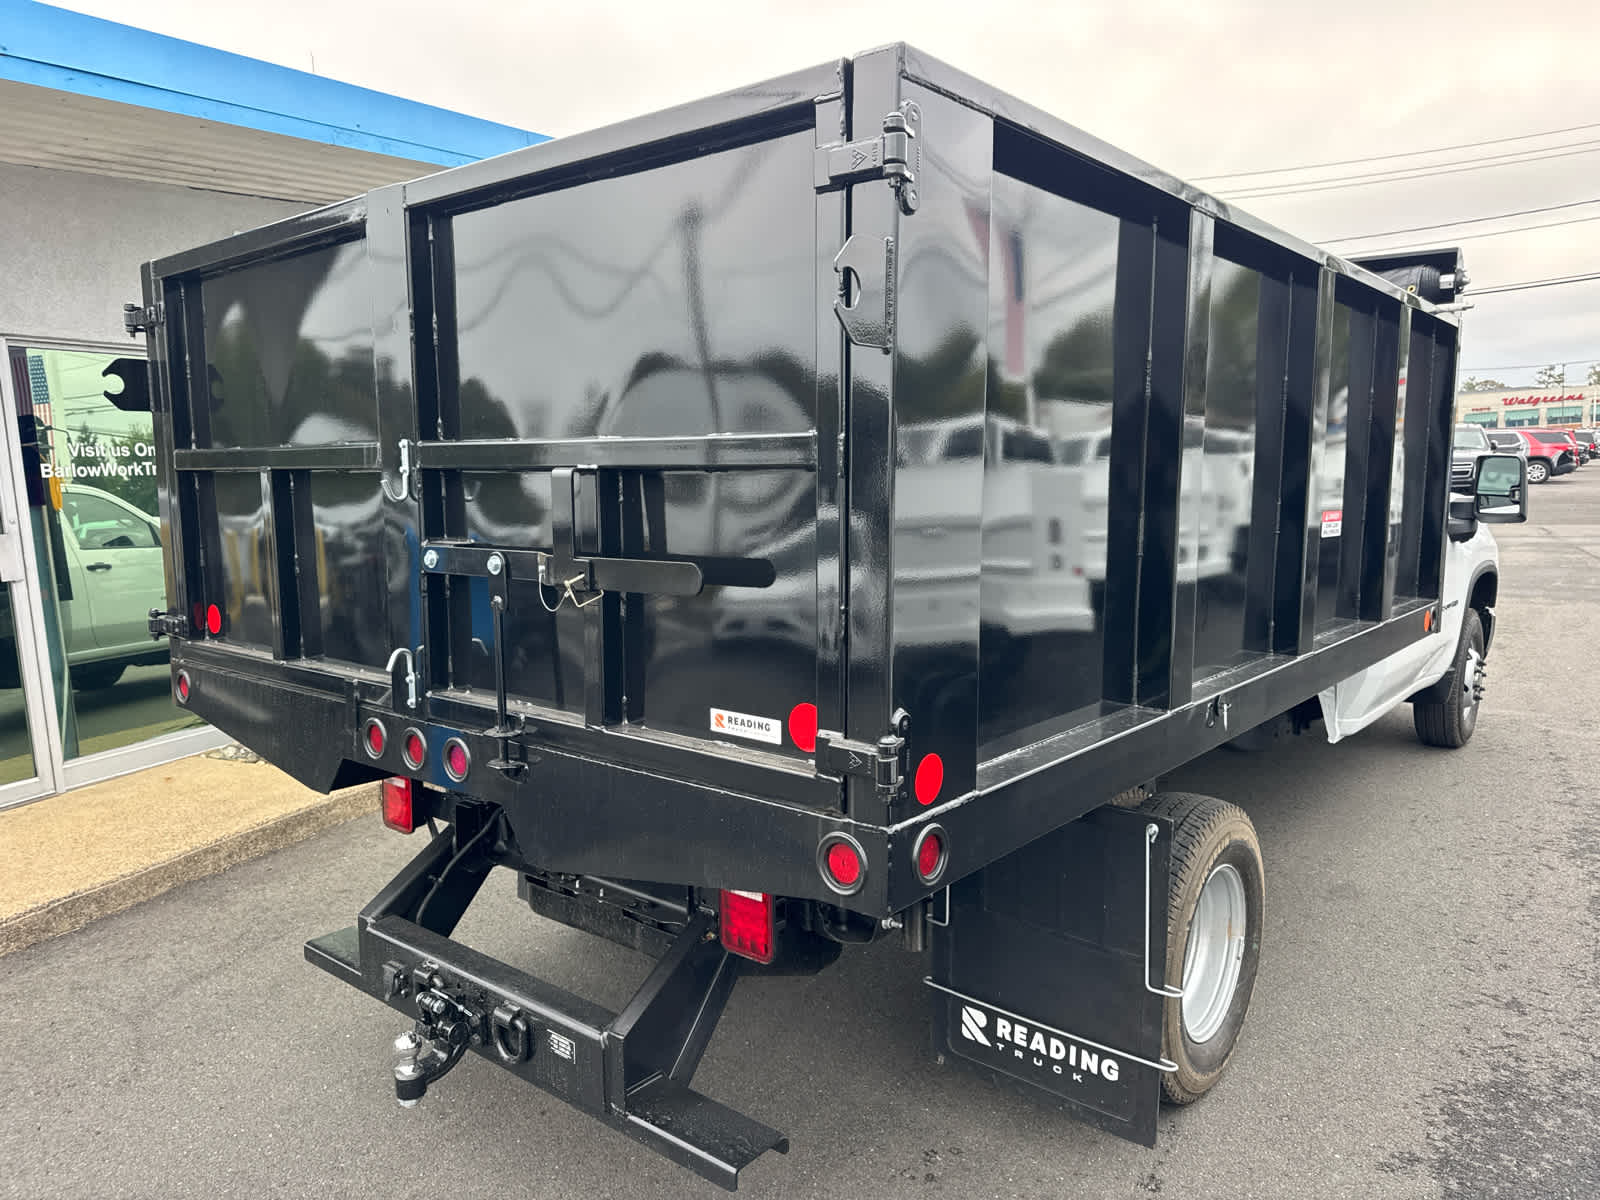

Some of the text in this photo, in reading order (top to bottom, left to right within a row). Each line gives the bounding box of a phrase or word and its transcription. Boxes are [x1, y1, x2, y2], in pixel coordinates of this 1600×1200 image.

[1502, 393, 1584, 407] Walgreens
[69, 442, 108, 457] Visit
[111, 444, 130, 457] us
[727, 715, 771, 732] READING
[996, 1017, 1120, 1081] READING
[996, 1042, 1083, 1083] TRUCK
